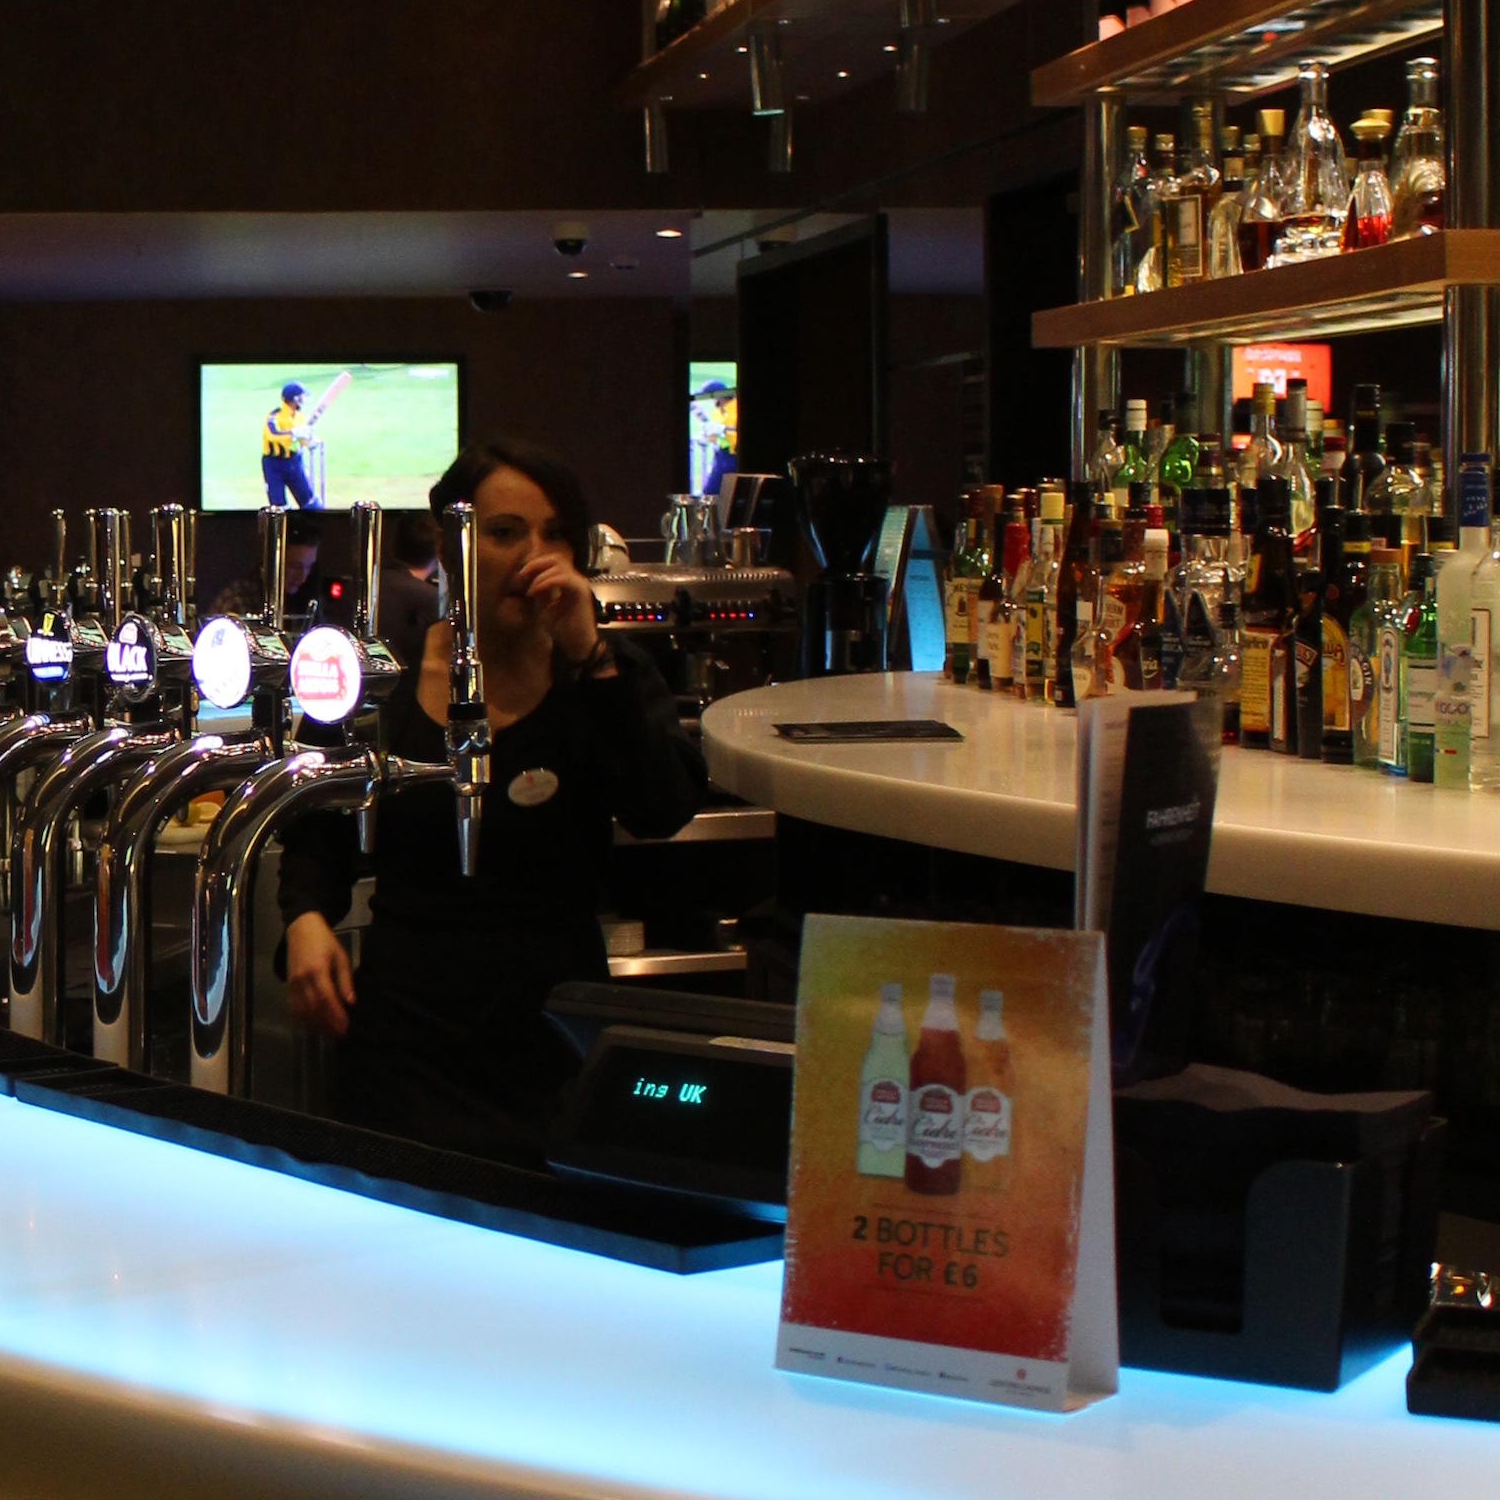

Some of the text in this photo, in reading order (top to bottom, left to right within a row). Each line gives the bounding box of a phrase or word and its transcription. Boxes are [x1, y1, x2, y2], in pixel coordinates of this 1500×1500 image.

[679, 1083, 707, 1104] UK
[854, 1215, 1008, 1258] 2 BOTTLES
[879, 1251, 978, 1289] FOR £6
